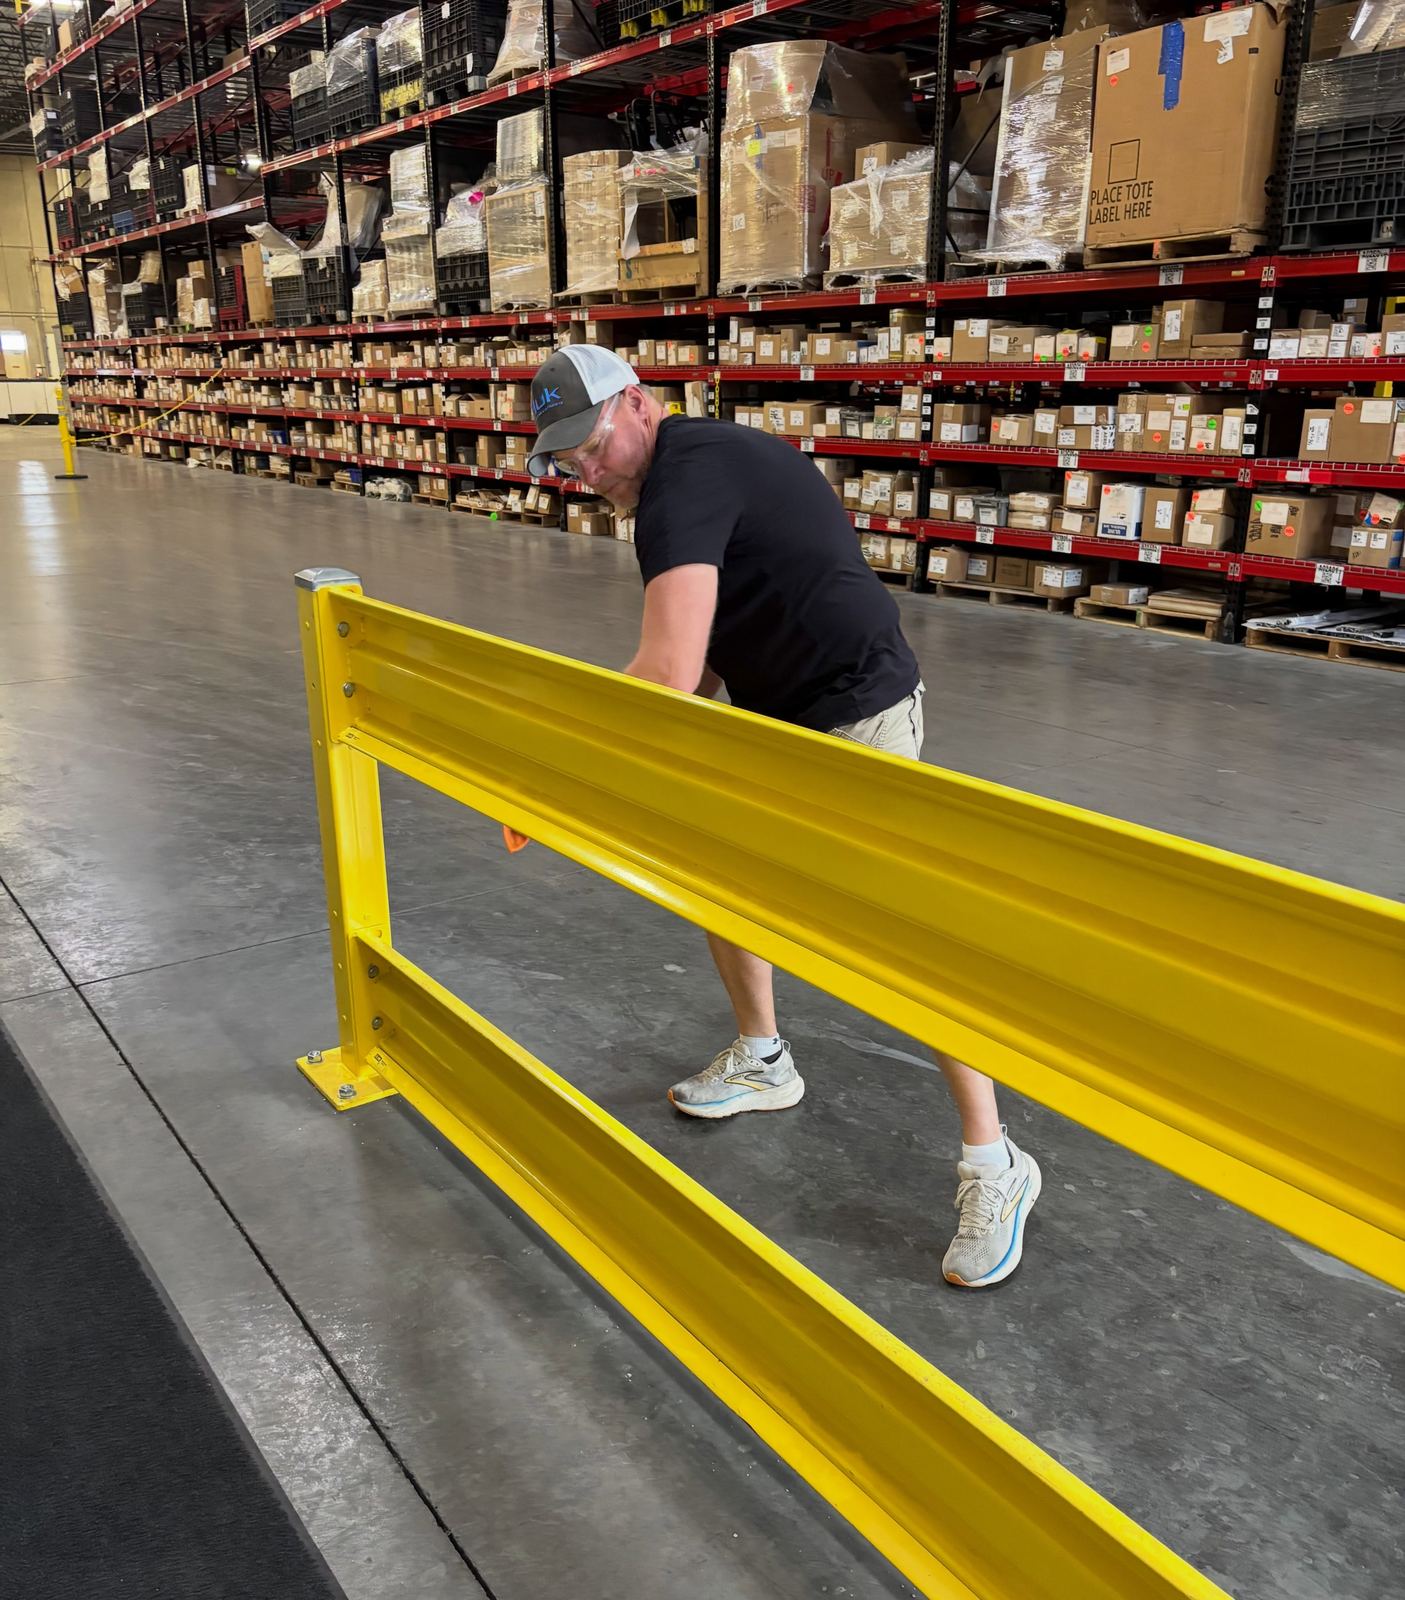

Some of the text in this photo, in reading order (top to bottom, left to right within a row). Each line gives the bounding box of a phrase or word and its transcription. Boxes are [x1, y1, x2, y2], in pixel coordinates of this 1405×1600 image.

[1090, 180, 1154, 206] PLACE TOTE
[1089, 200, 1152, 225] LABEL HERE
